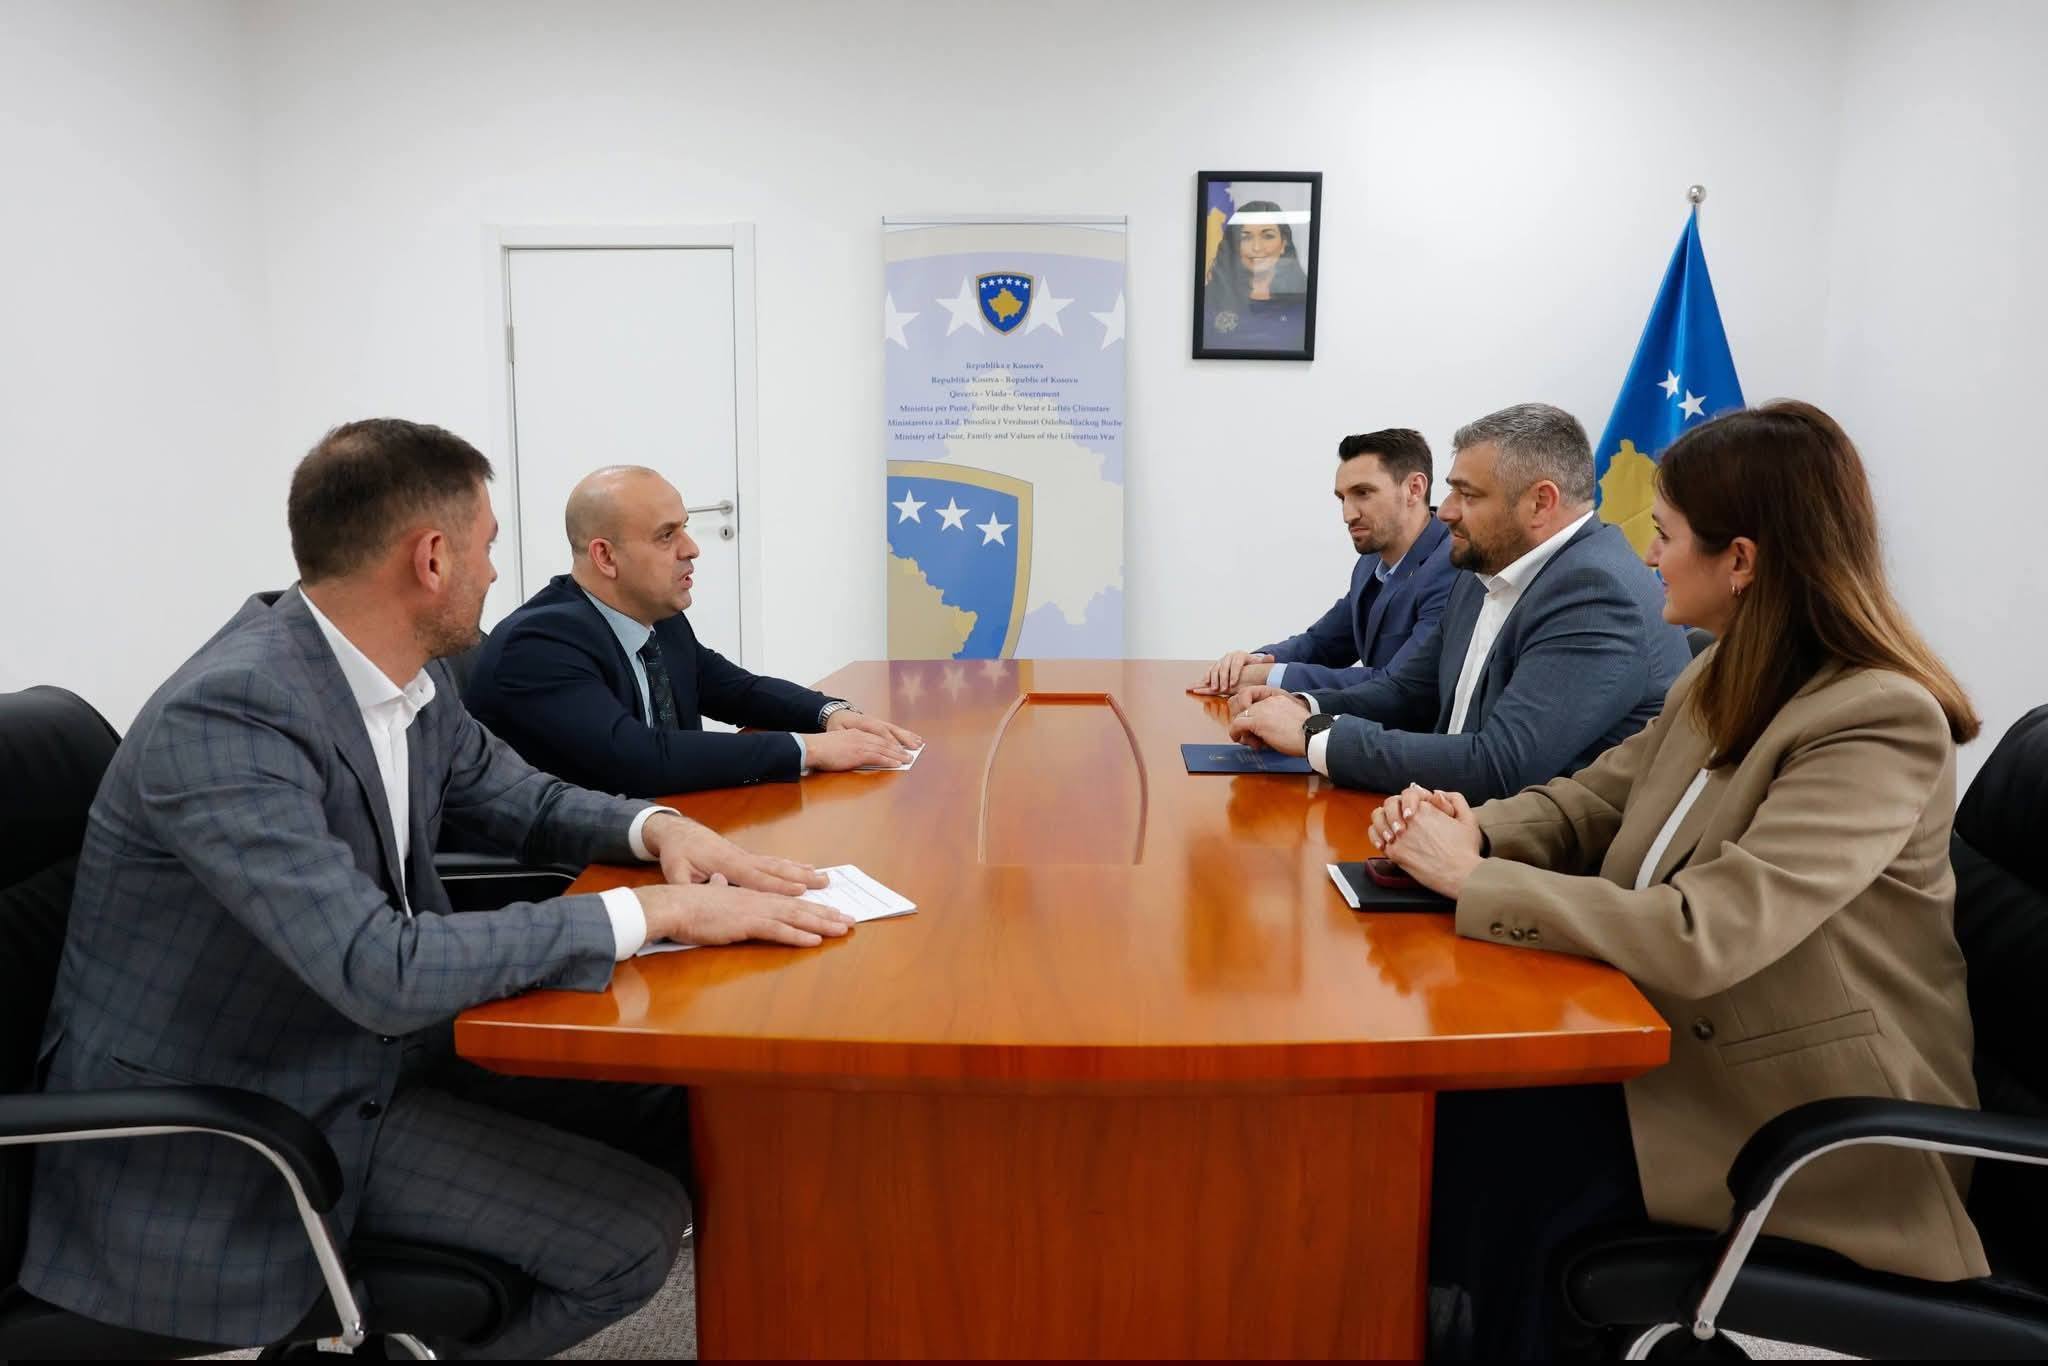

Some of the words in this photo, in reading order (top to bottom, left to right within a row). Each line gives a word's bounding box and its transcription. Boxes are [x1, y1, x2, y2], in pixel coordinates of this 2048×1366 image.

[1005, 375, 1039, 385] Republic
[1040, 375, 1049, 384] of
[984, 389, 1007, 398] Vlada
[1013, 390, 1060, 399] Government
[1000, 404, 1015, 412] dhe
[894, 432, 926, 443] Ministry
[967, 432, 993, 442] Family
[994, 432, 1008, 440] and
[1010, 432, 1036, 441] Values
[1037, 432, 1046, 440] of
[1046, 432, 1059, 440] the
[1060, 432, 1099, 441] Liberation
